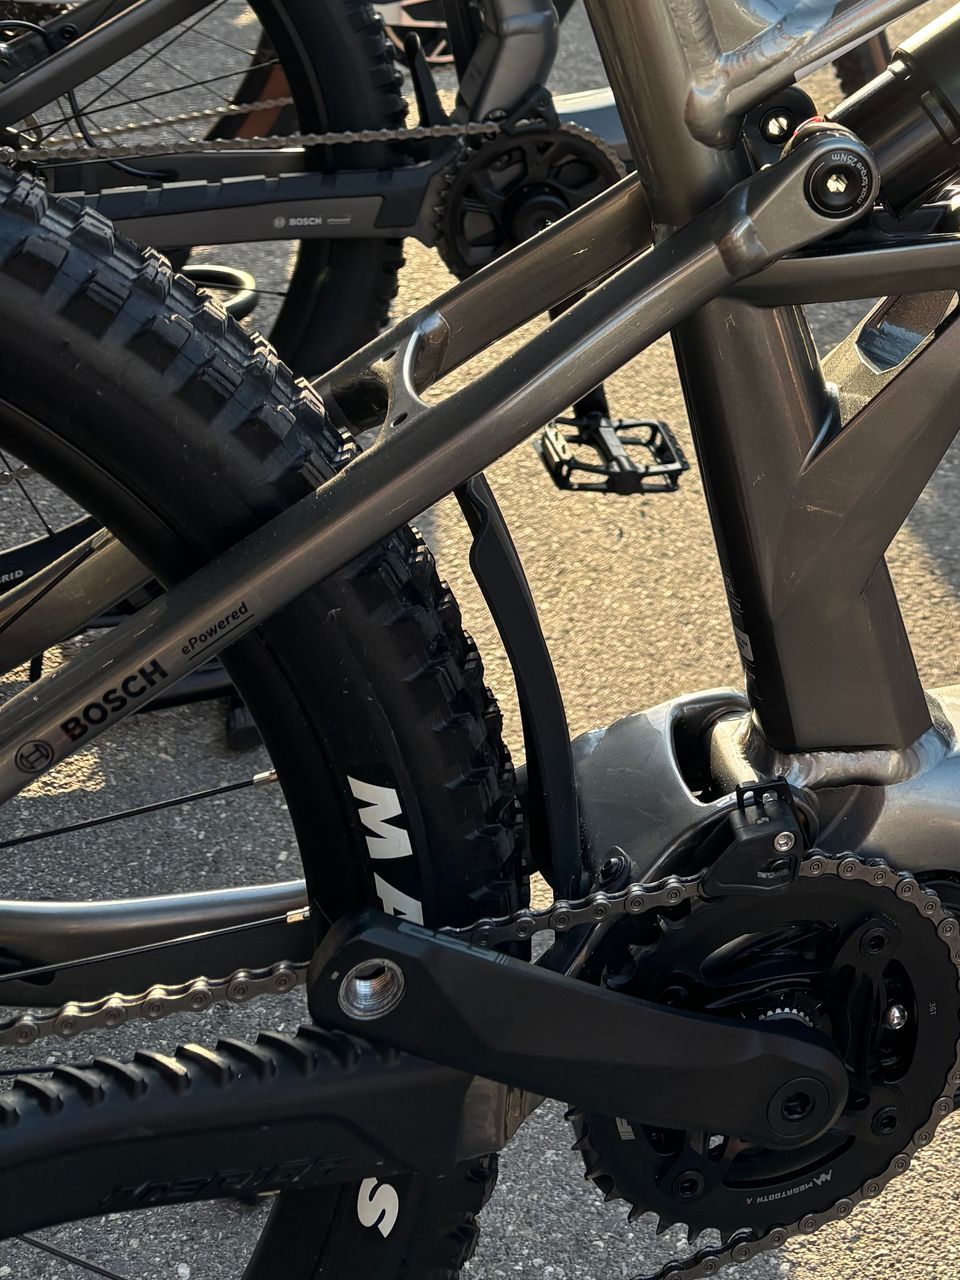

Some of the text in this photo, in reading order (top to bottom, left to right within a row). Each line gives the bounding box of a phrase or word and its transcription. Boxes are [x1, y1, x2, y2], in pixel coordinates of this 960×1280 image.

[289, 217, 322, 226] BOSCH
[0, 570, 24, 583] RID
[60, 601, 249, 742] BOSCH ePowered
